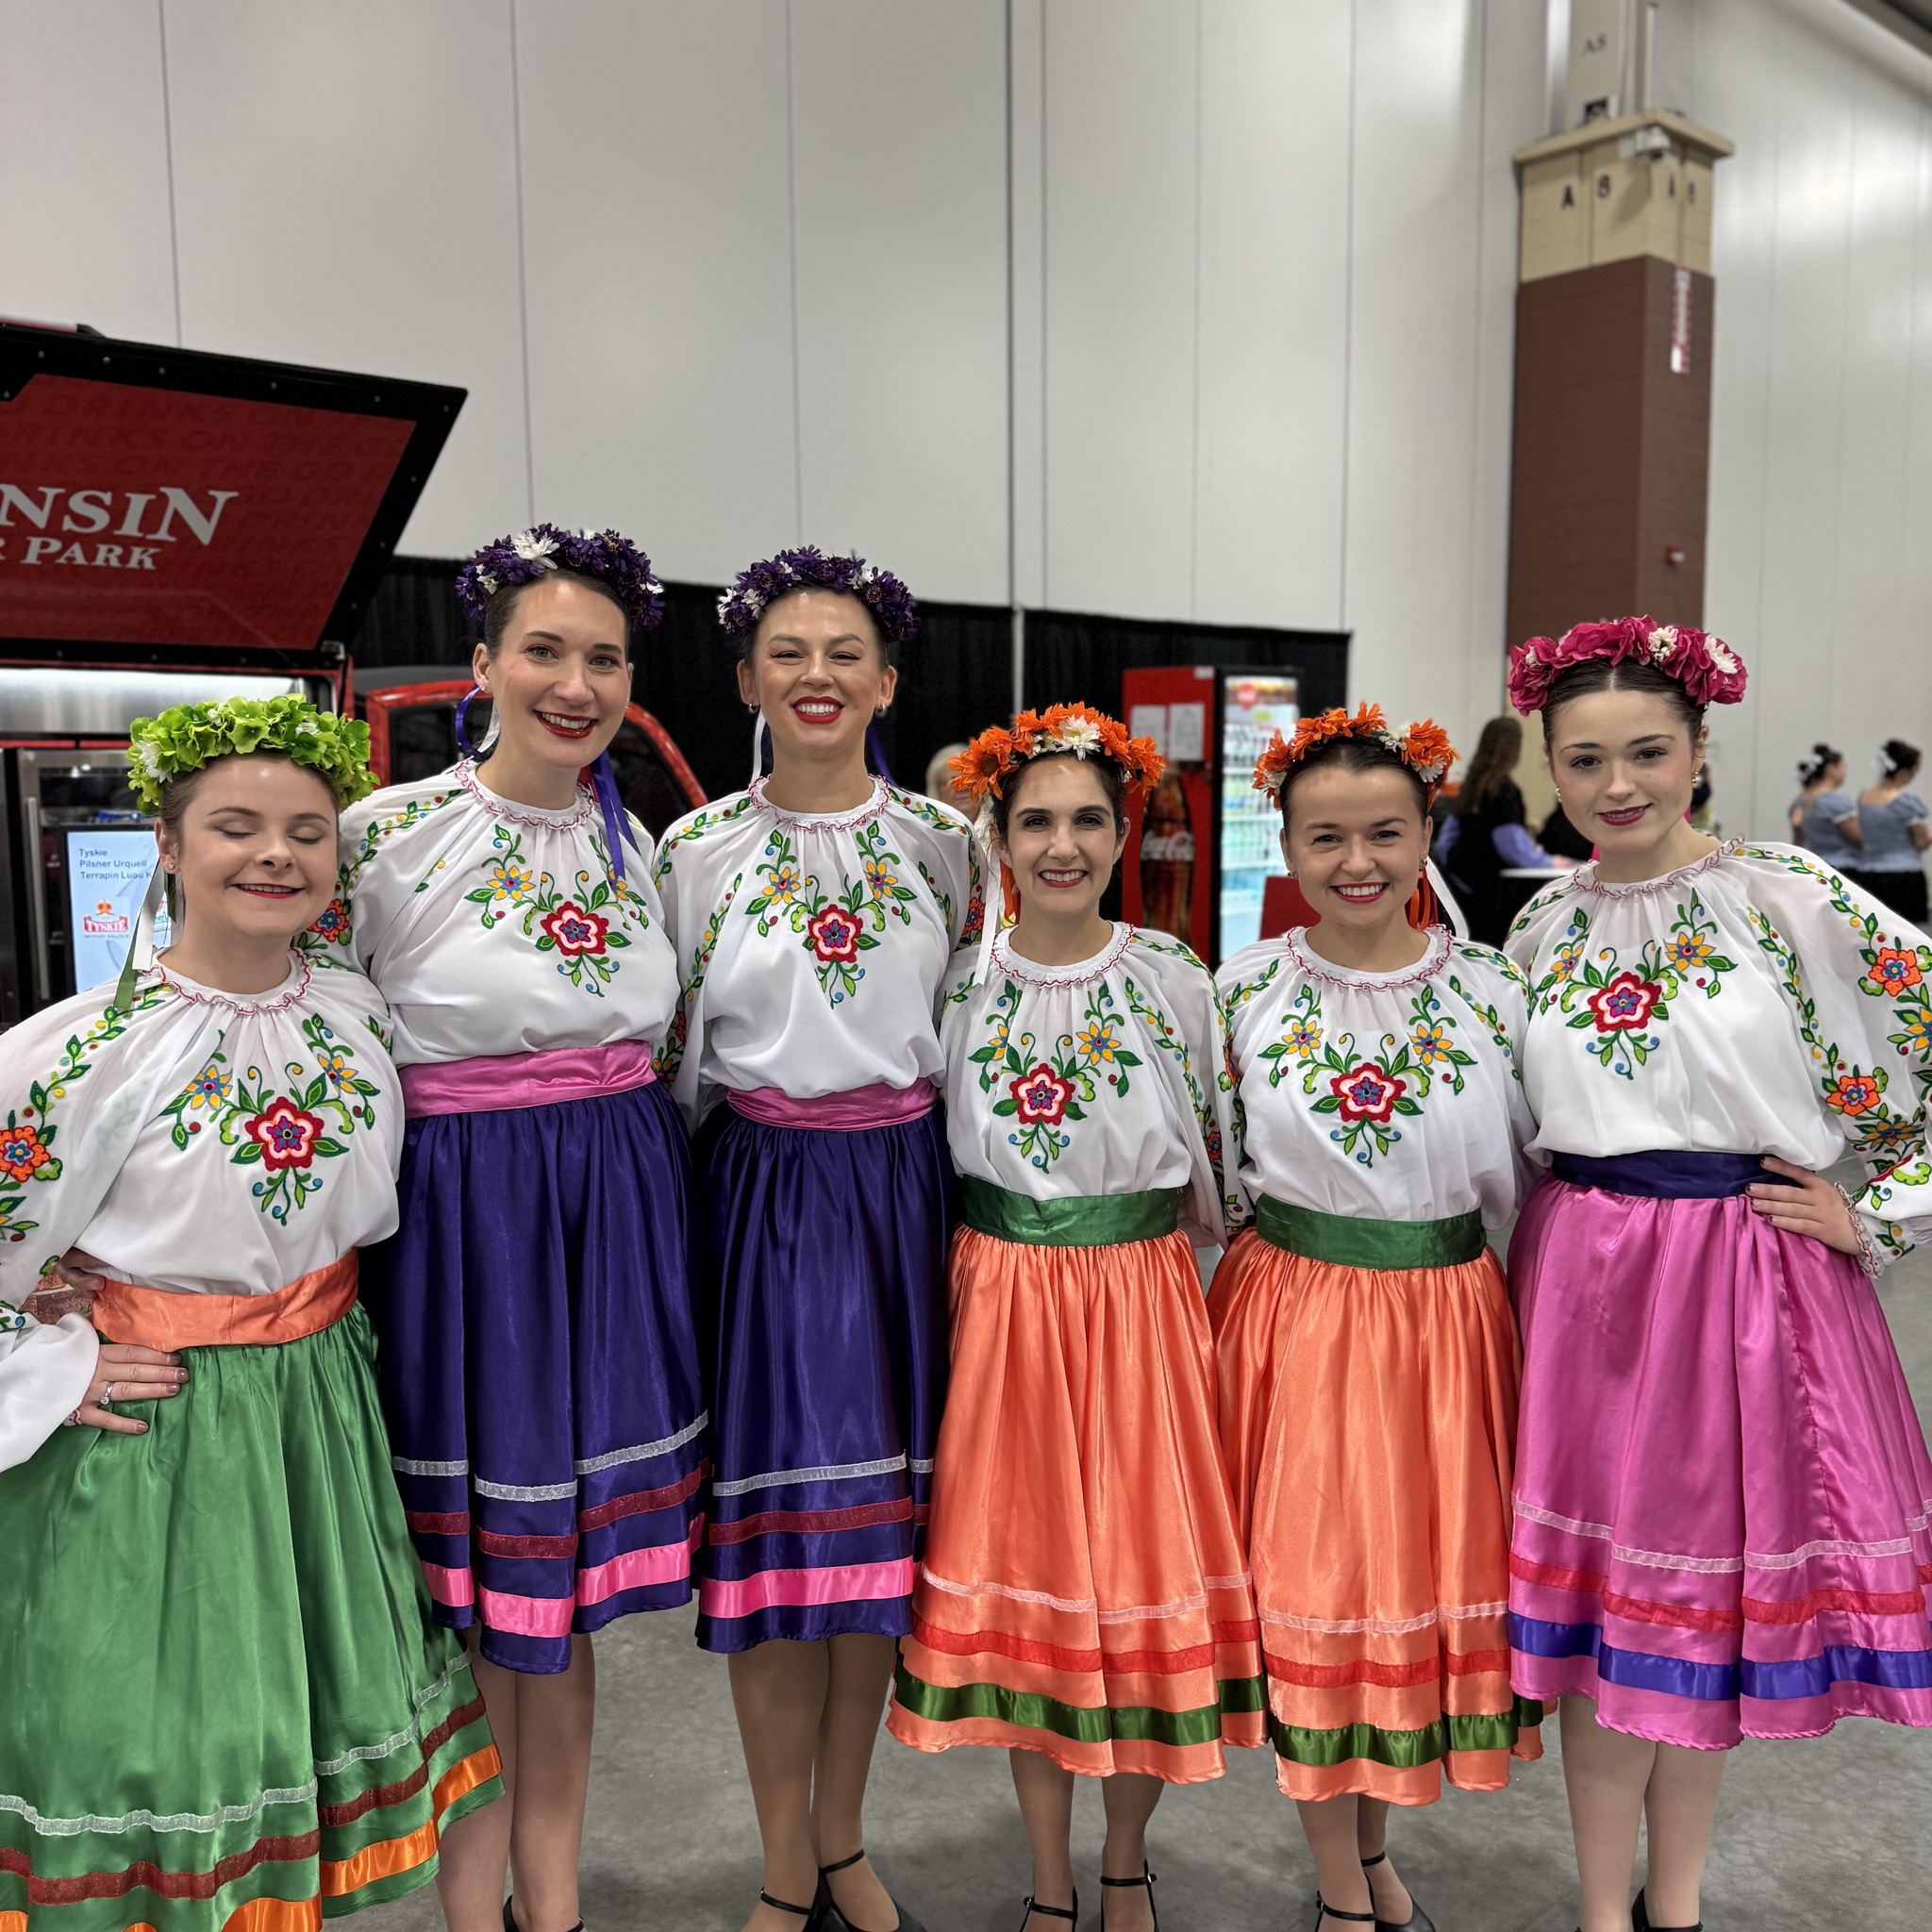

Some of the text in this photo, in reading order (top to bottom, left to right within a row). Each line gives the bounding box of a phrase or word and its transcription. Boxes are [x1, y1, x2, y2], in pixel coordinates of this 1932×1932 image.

[1560, 184, 1574, 209] A
[180, 429, 253, 453] ON
[20, 536, 162, 571] PARK
[79, 848, 108, 858] Tyskie
[79, 859, 147, 869] Pilsner Urquell
[80, 871, 119, 880] Terrapin
[86, 919, 127, 932] TYSKIE
